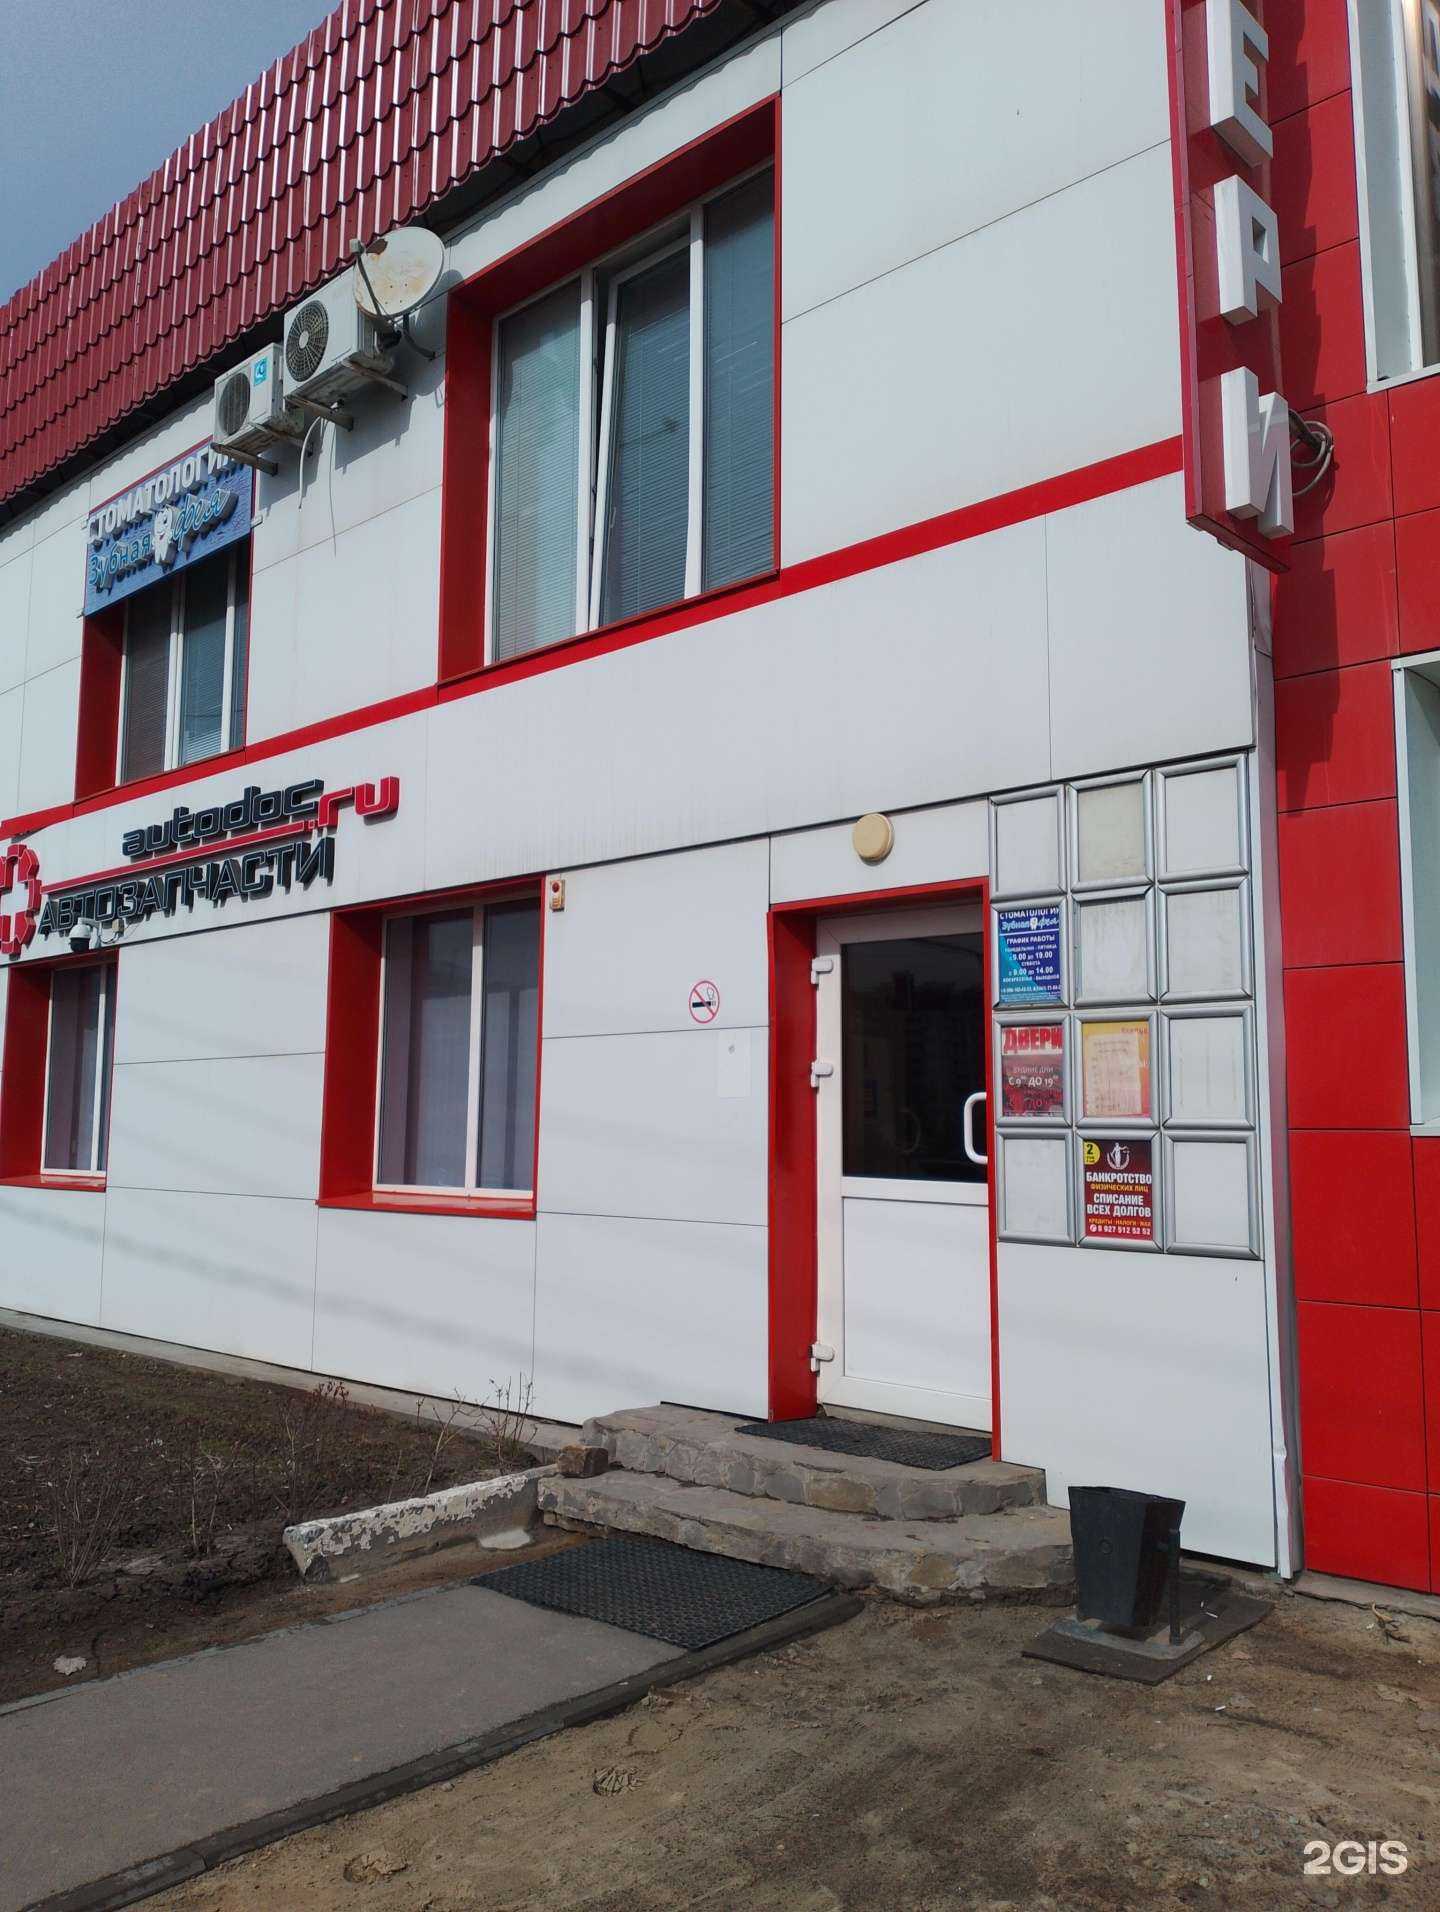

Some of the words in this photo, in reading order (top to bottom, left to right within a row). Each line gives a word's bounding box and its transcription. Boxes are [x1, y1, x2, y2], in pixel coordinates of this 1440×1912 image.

[88, 447, 232, 545] СТОМАТОЛОГИ
[89, 533, 152, 586] Зубная
[38, 837, 335, 937] АВТОЗАПЧАСТИ
[1007, 937, 1029, 945] ГРАФИК
[1030, 934, 1055, 943] РАБОТЫ
[1004, 1027, 1063, 1054] ДВЕРИ
[1028, 1076, 1042, 1088] ДО
[1086, 1143, 1094, 1155] 2
[1086, 1171, 1152, 1185] БАНКРОТСТВО
[1090, 1183, 1133, 1192] ФИЗИЧЕСКИХ
[1134, 1185, 1149, 1193] ЛИЦ
[1093, 1193, 1144, 1206] СПИСАНИЕ
[1087, 1203, 1110, 1215] ВСЕХ
[1113, 1204, 1151, 1217] ДОЛГОВ
[1103, 1225, 1116, 1233] 927
